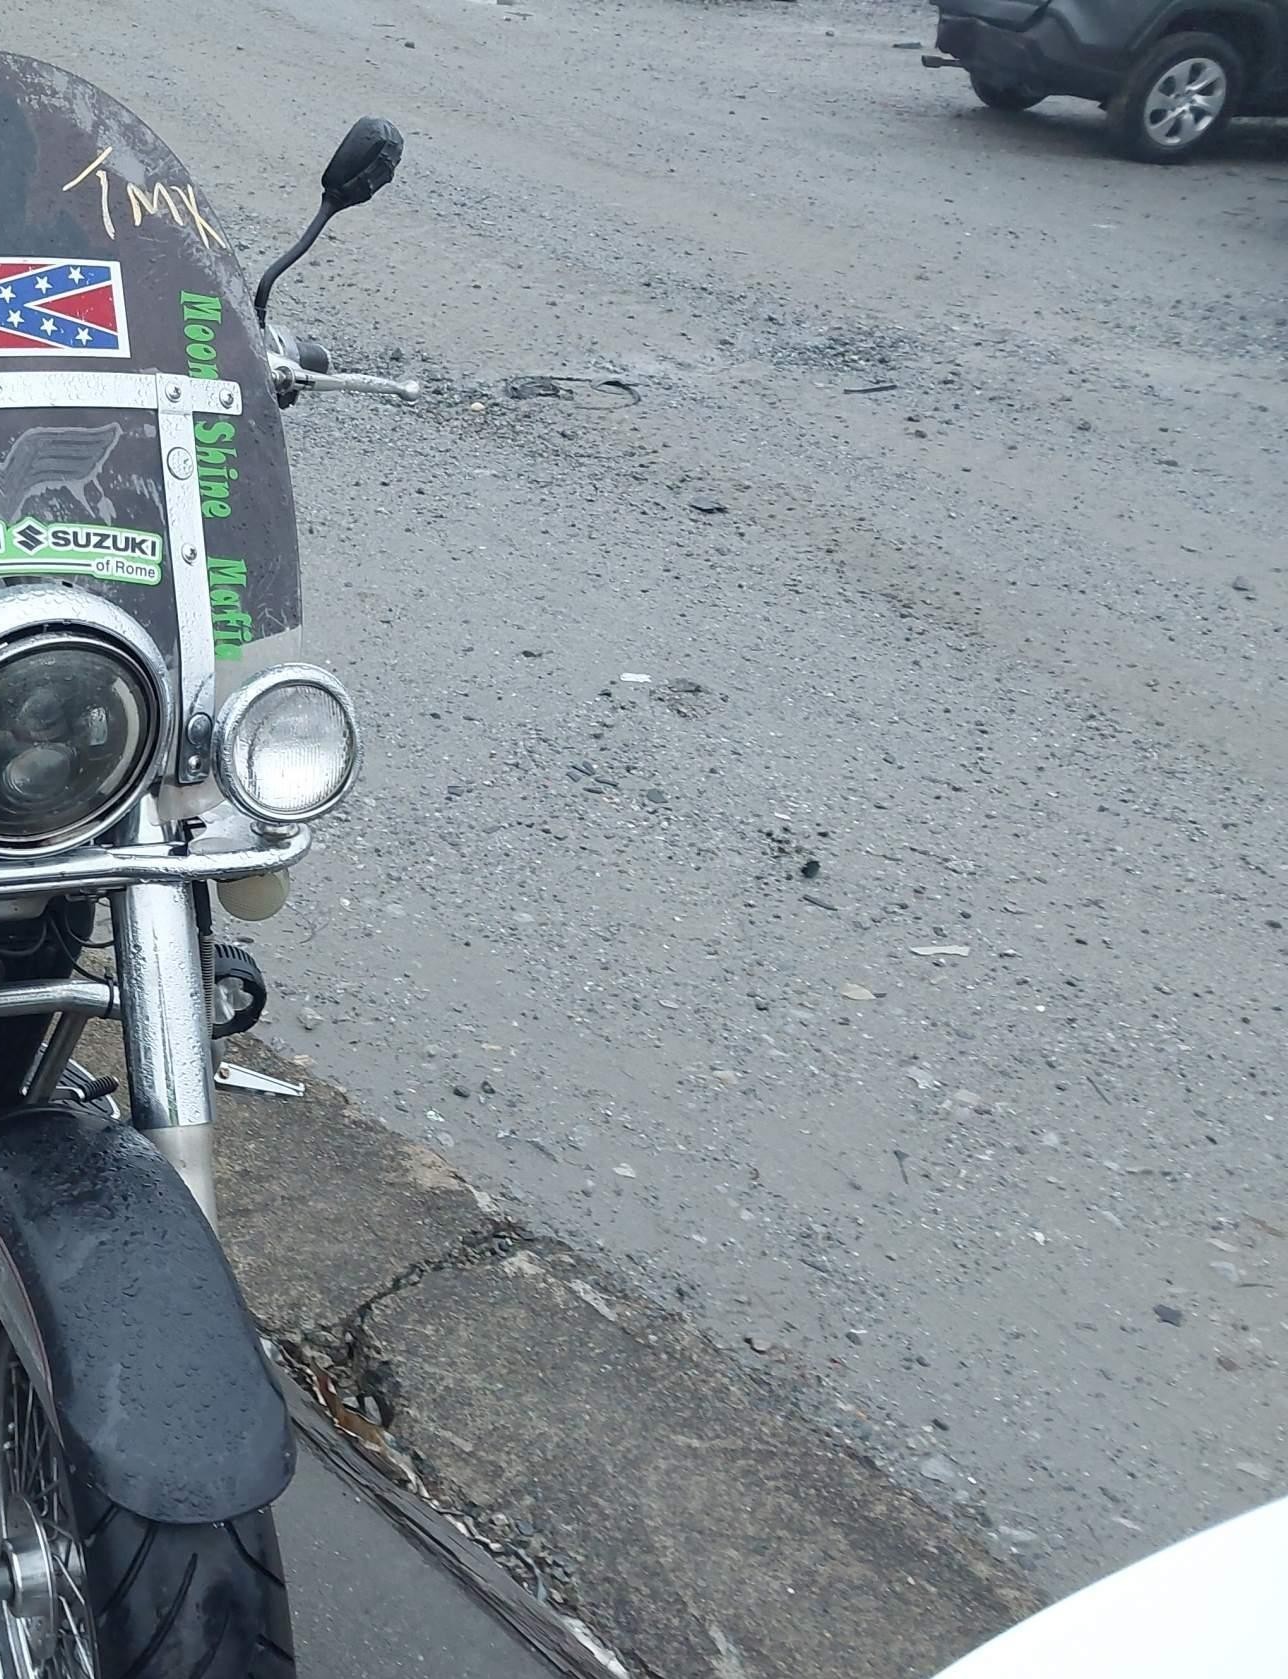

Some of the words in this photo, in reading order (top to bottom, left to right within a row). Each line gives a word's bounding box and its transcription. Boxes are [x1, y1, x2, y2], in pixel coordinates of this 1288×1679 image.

[181, 290, 222, 379] Moon
[194, 421, 239, 518] Shine
[51, 529, 157, 557] SUZUKI
[96, 560, 112, 572] of
[115, 561, 156, 578] Rome
